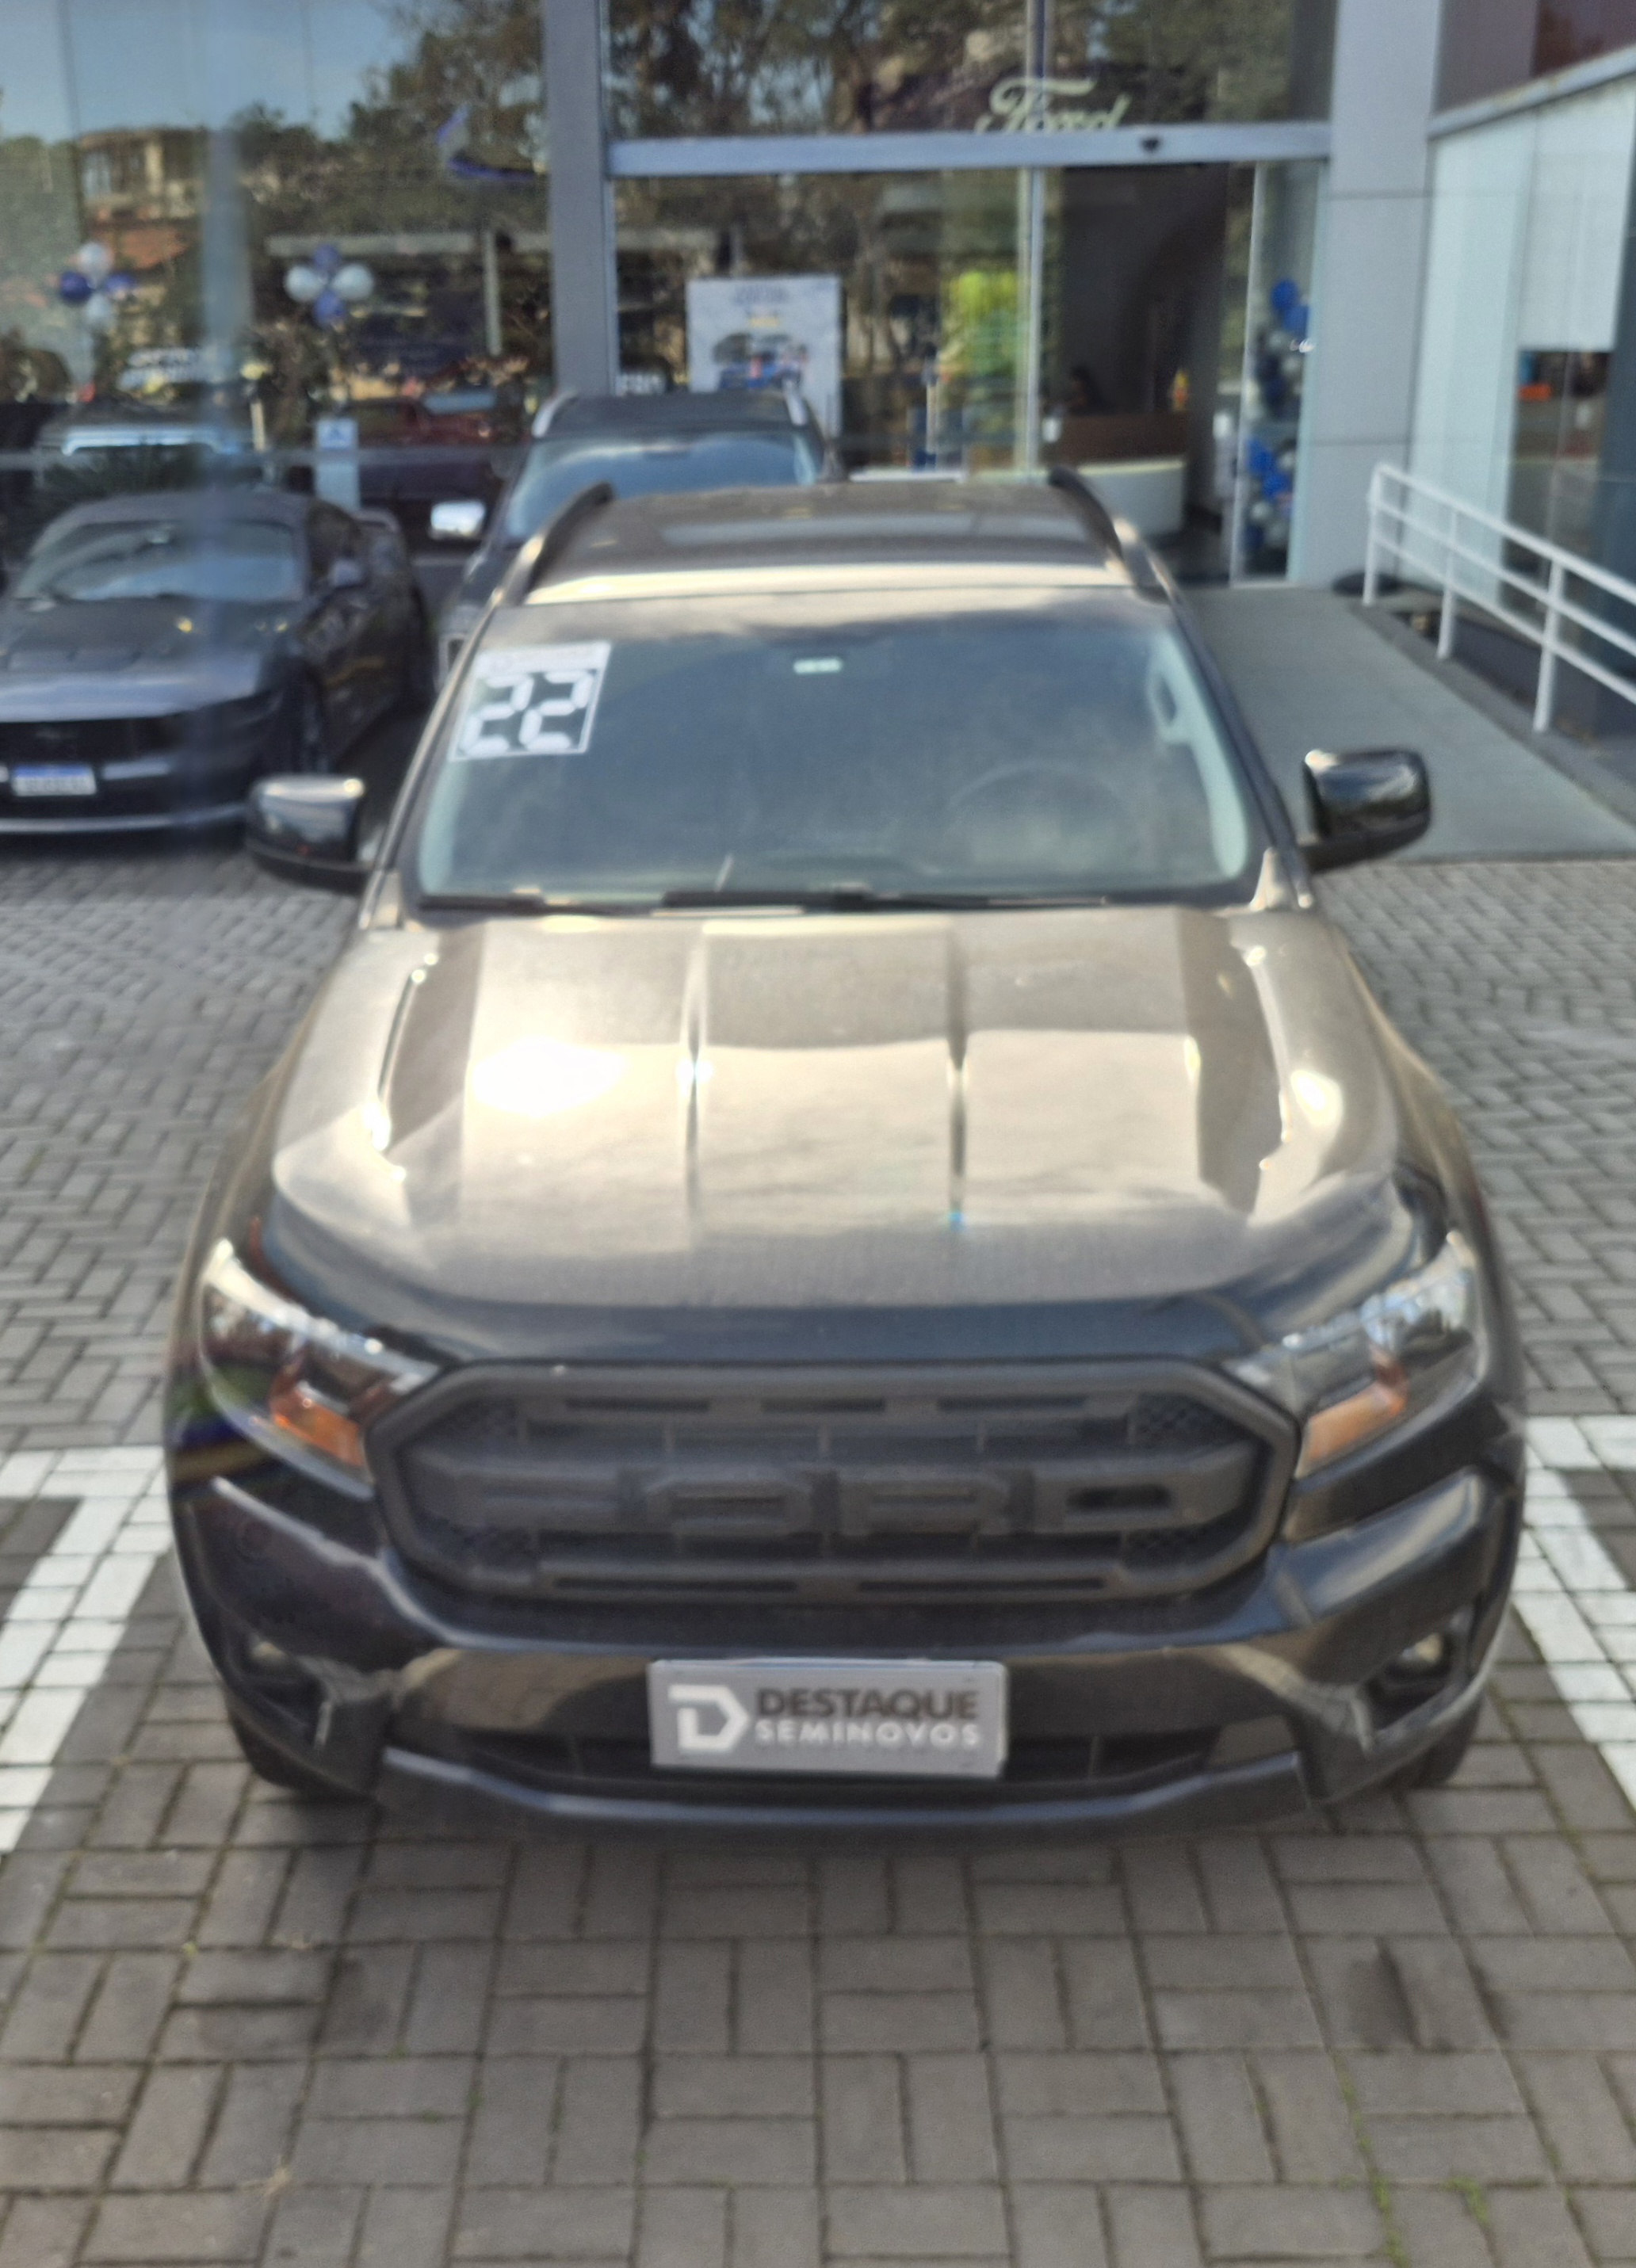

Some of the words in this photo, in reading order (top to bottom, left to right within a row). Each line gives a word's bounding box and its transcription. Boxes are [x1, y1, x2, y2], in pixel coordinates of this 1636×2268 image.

[458, 672, 594, 757] 22
[756, 1688, 980, 1719] DESTAQUE
[755, 1720, 981, 1746] SEMINOVOS
